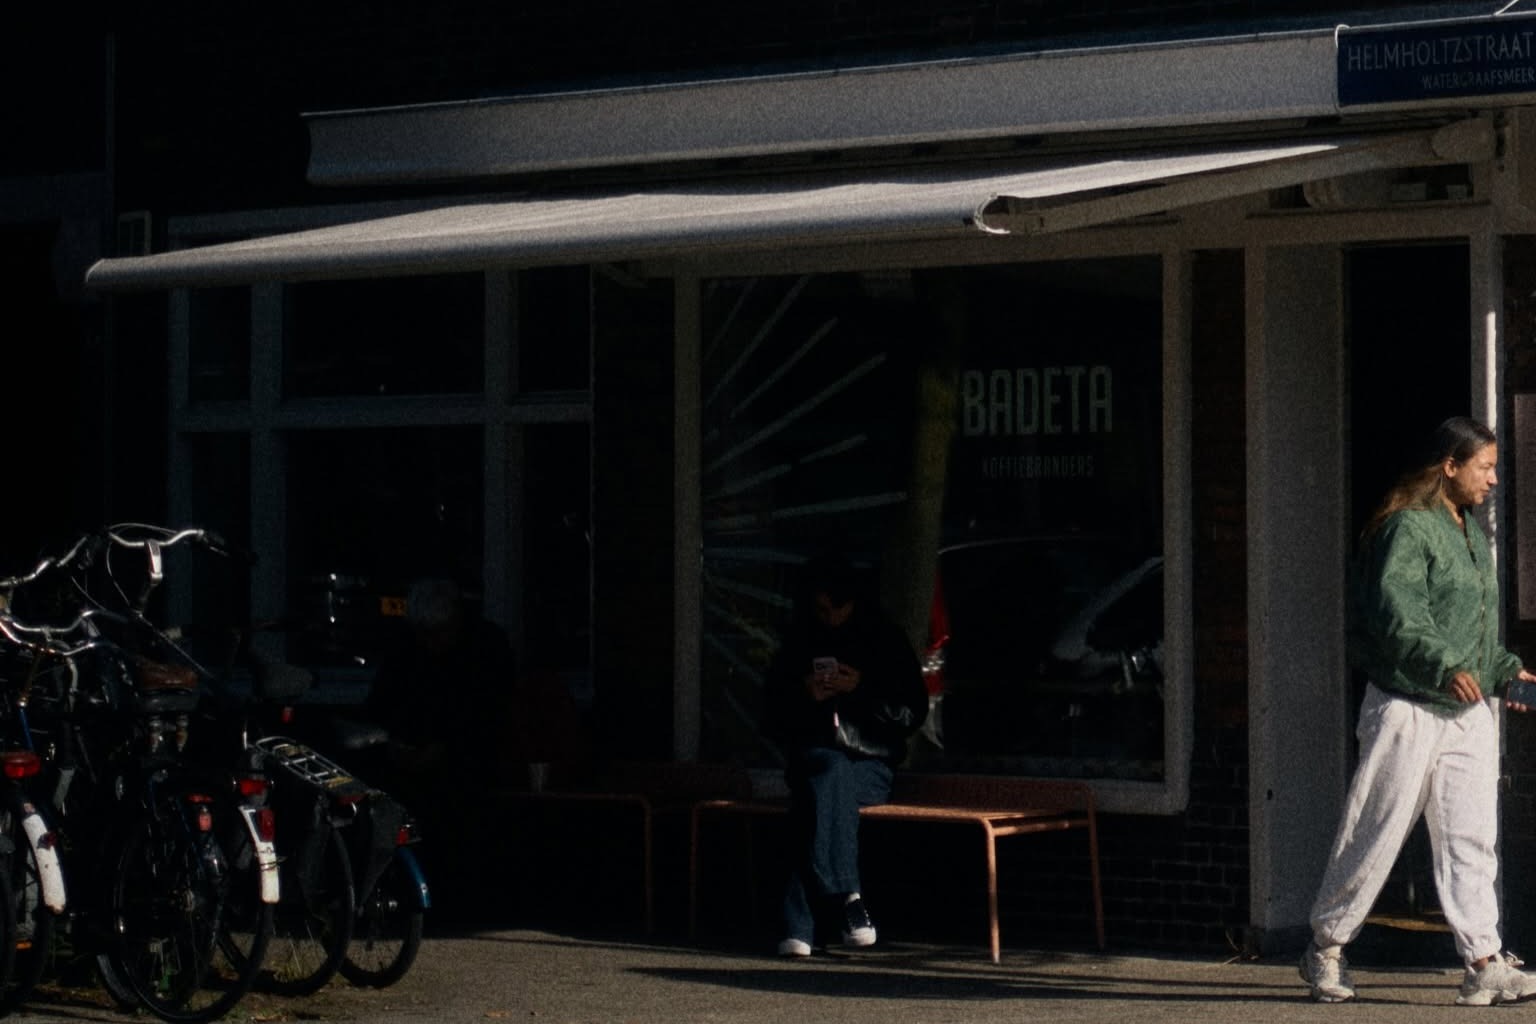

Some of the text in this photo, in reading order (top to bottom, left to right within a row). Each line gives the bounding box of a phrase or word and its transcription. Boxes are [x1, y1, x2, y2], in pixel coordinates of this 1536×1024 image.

[1346, 31, 1535, 72] HELMHOLTZSTRAAT
[1421, 65, 1536, 90] WATERGRAAFSMEER
[961, 364, 1114, 438] BADETA
